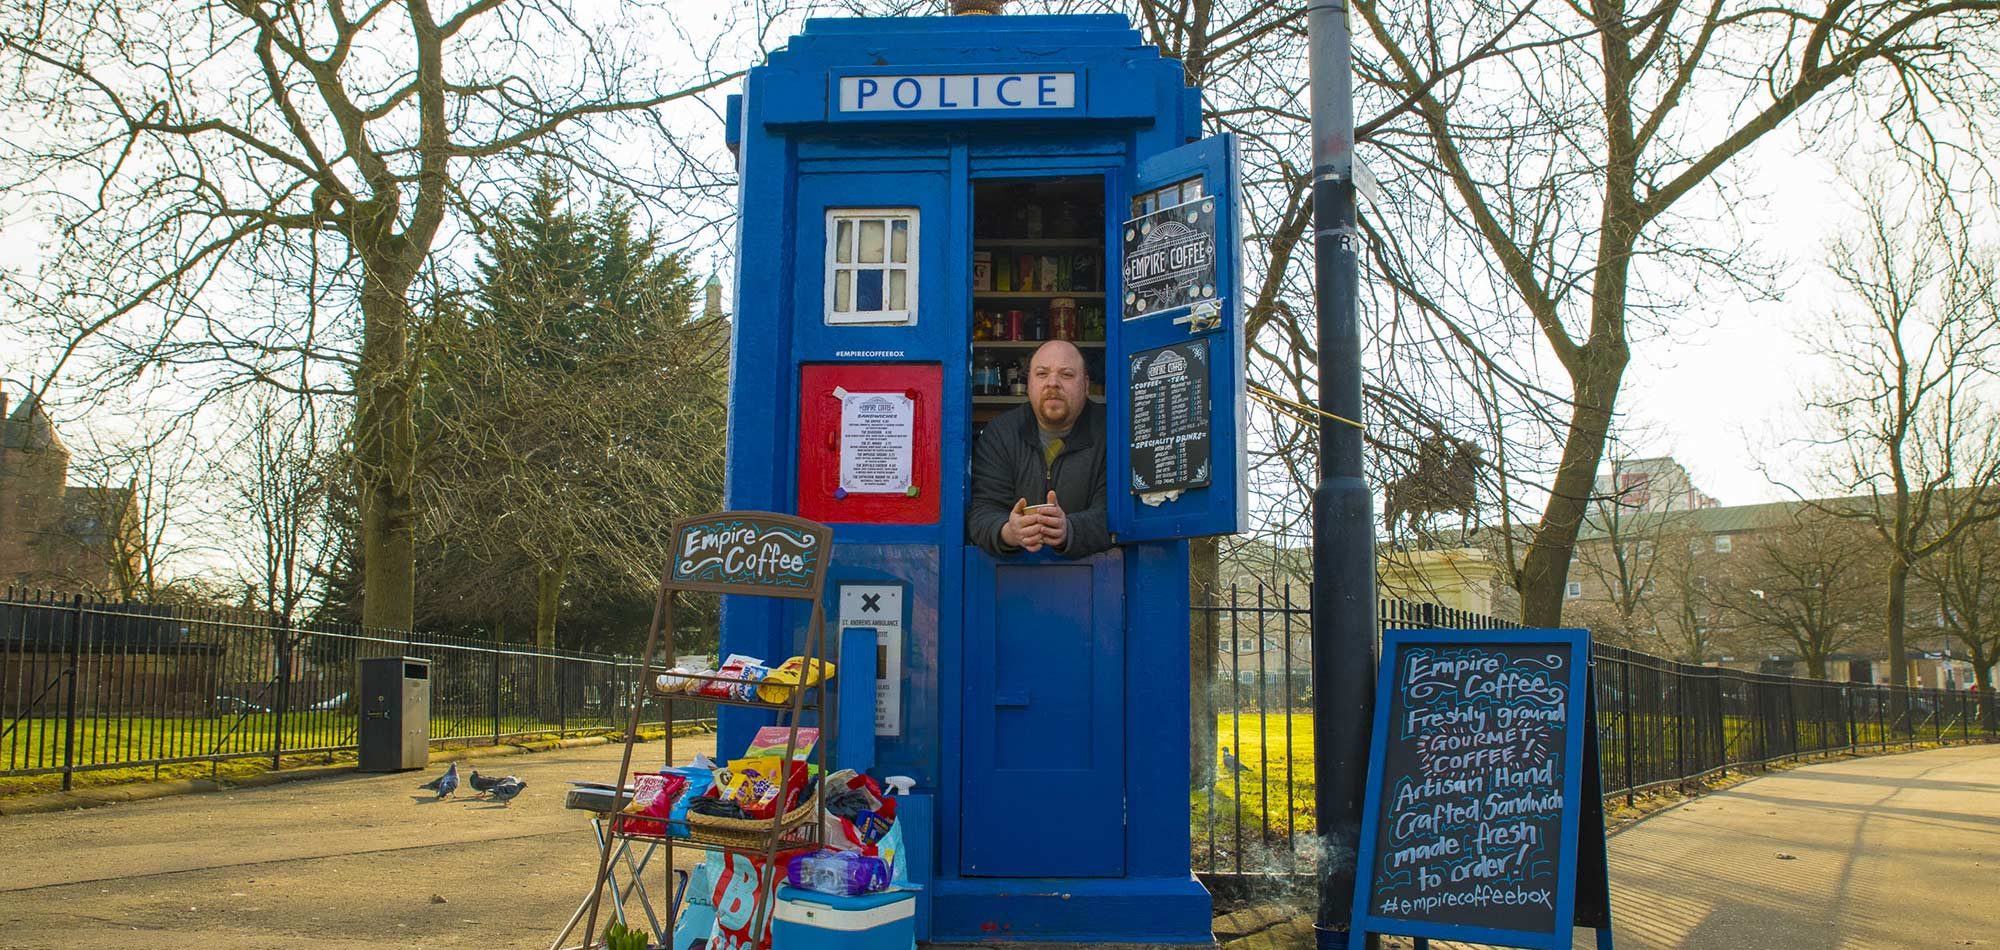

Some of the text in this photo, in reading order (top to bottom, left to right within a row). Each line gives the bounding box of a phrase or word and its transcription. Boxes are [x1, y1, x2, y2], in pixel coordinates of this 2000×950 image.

[857, 76, 1057, 109] POLICE
[1131, 241, 1206, 281] EMPIRE COFFEE
[835, 350, 905, 358] #EMPIRECOFFEEBOX
[1134, 380, 1160, 390] COFFEE
[1135, 431, 1202, 449] SPECIALITY DRINKS
[684, 527, 756, 558] Empire
[725, 543, 804, 577] Coffee
[872, 619, 899, 627] AMBULANCE
[1407, 655, 1500, 684] Empire
[1464, 673, 1550, 699] Coffee
[1407, 703, 1565, 733] Freshly ground
[1430, 727, 1534, 751] GOURMET
[1395, 760, 1552, 811] Artisan Hand
[1395, 789, 1563, 840] Crafted Sandwich
[1394, 821, 1536, 868] made fresh
[1418, 843, 1530, 891] to order!
[1379, 883, 1553, 915] #empirecoffeebox
